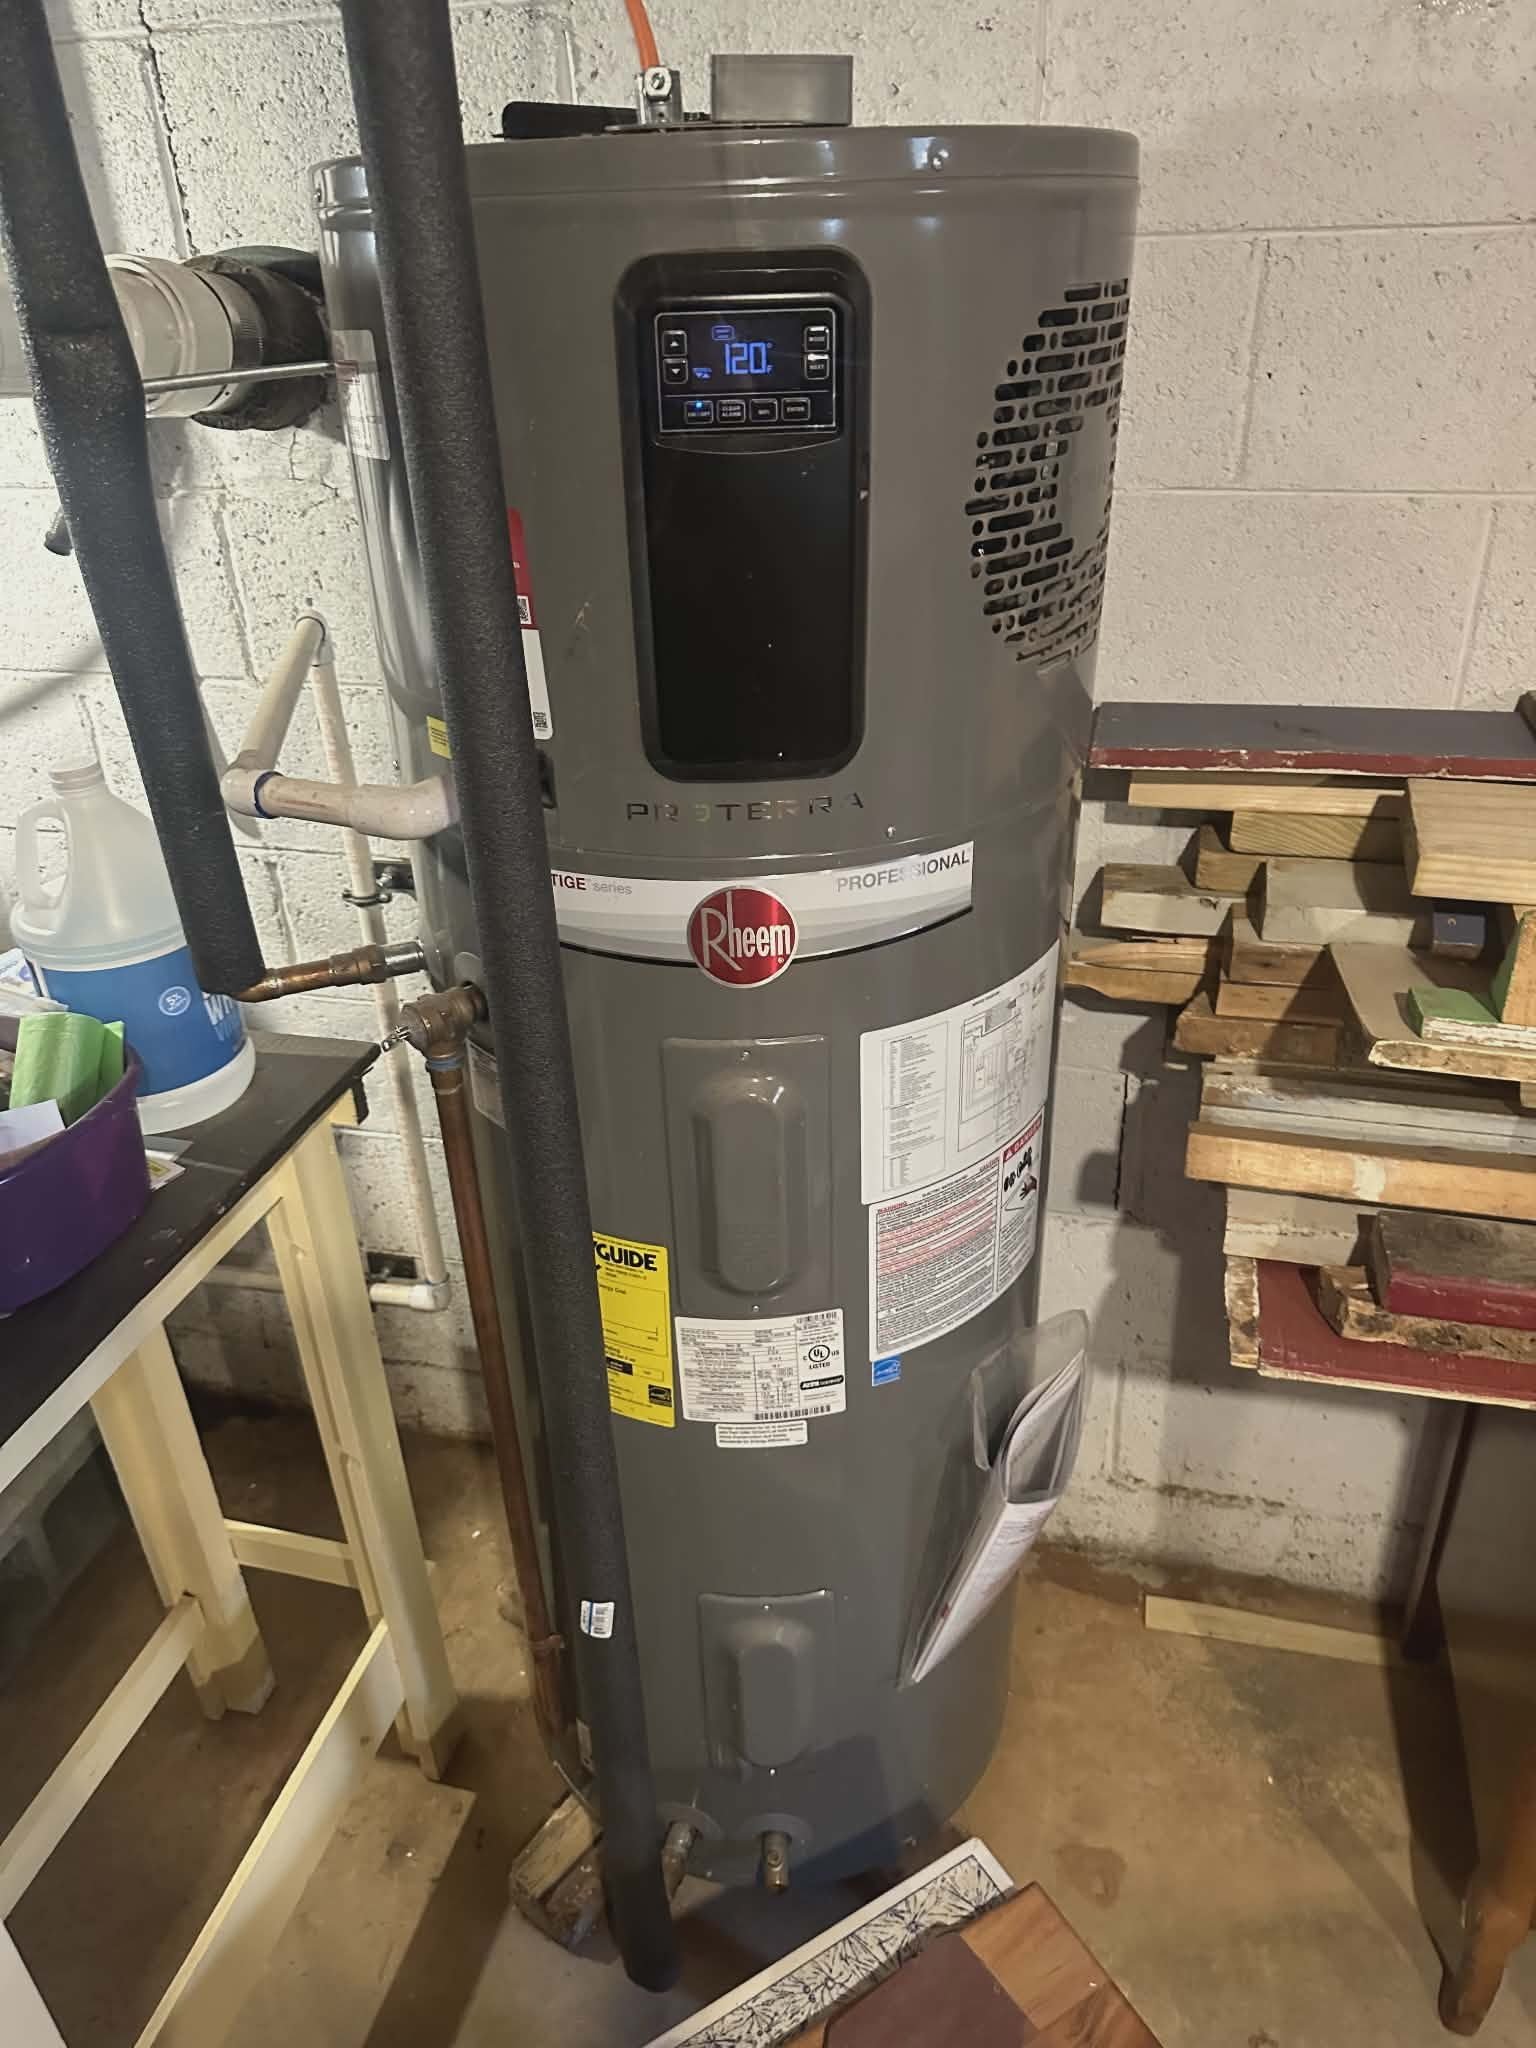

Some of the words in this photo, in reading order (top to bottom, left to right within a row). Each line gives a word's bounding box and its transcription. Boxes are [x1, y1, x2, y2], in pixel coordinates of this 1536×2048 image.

[626, 792, 864, 822] PROTERRA
[592, 882, 633, 895] series
[701, 890, 792, 971] Rheem
